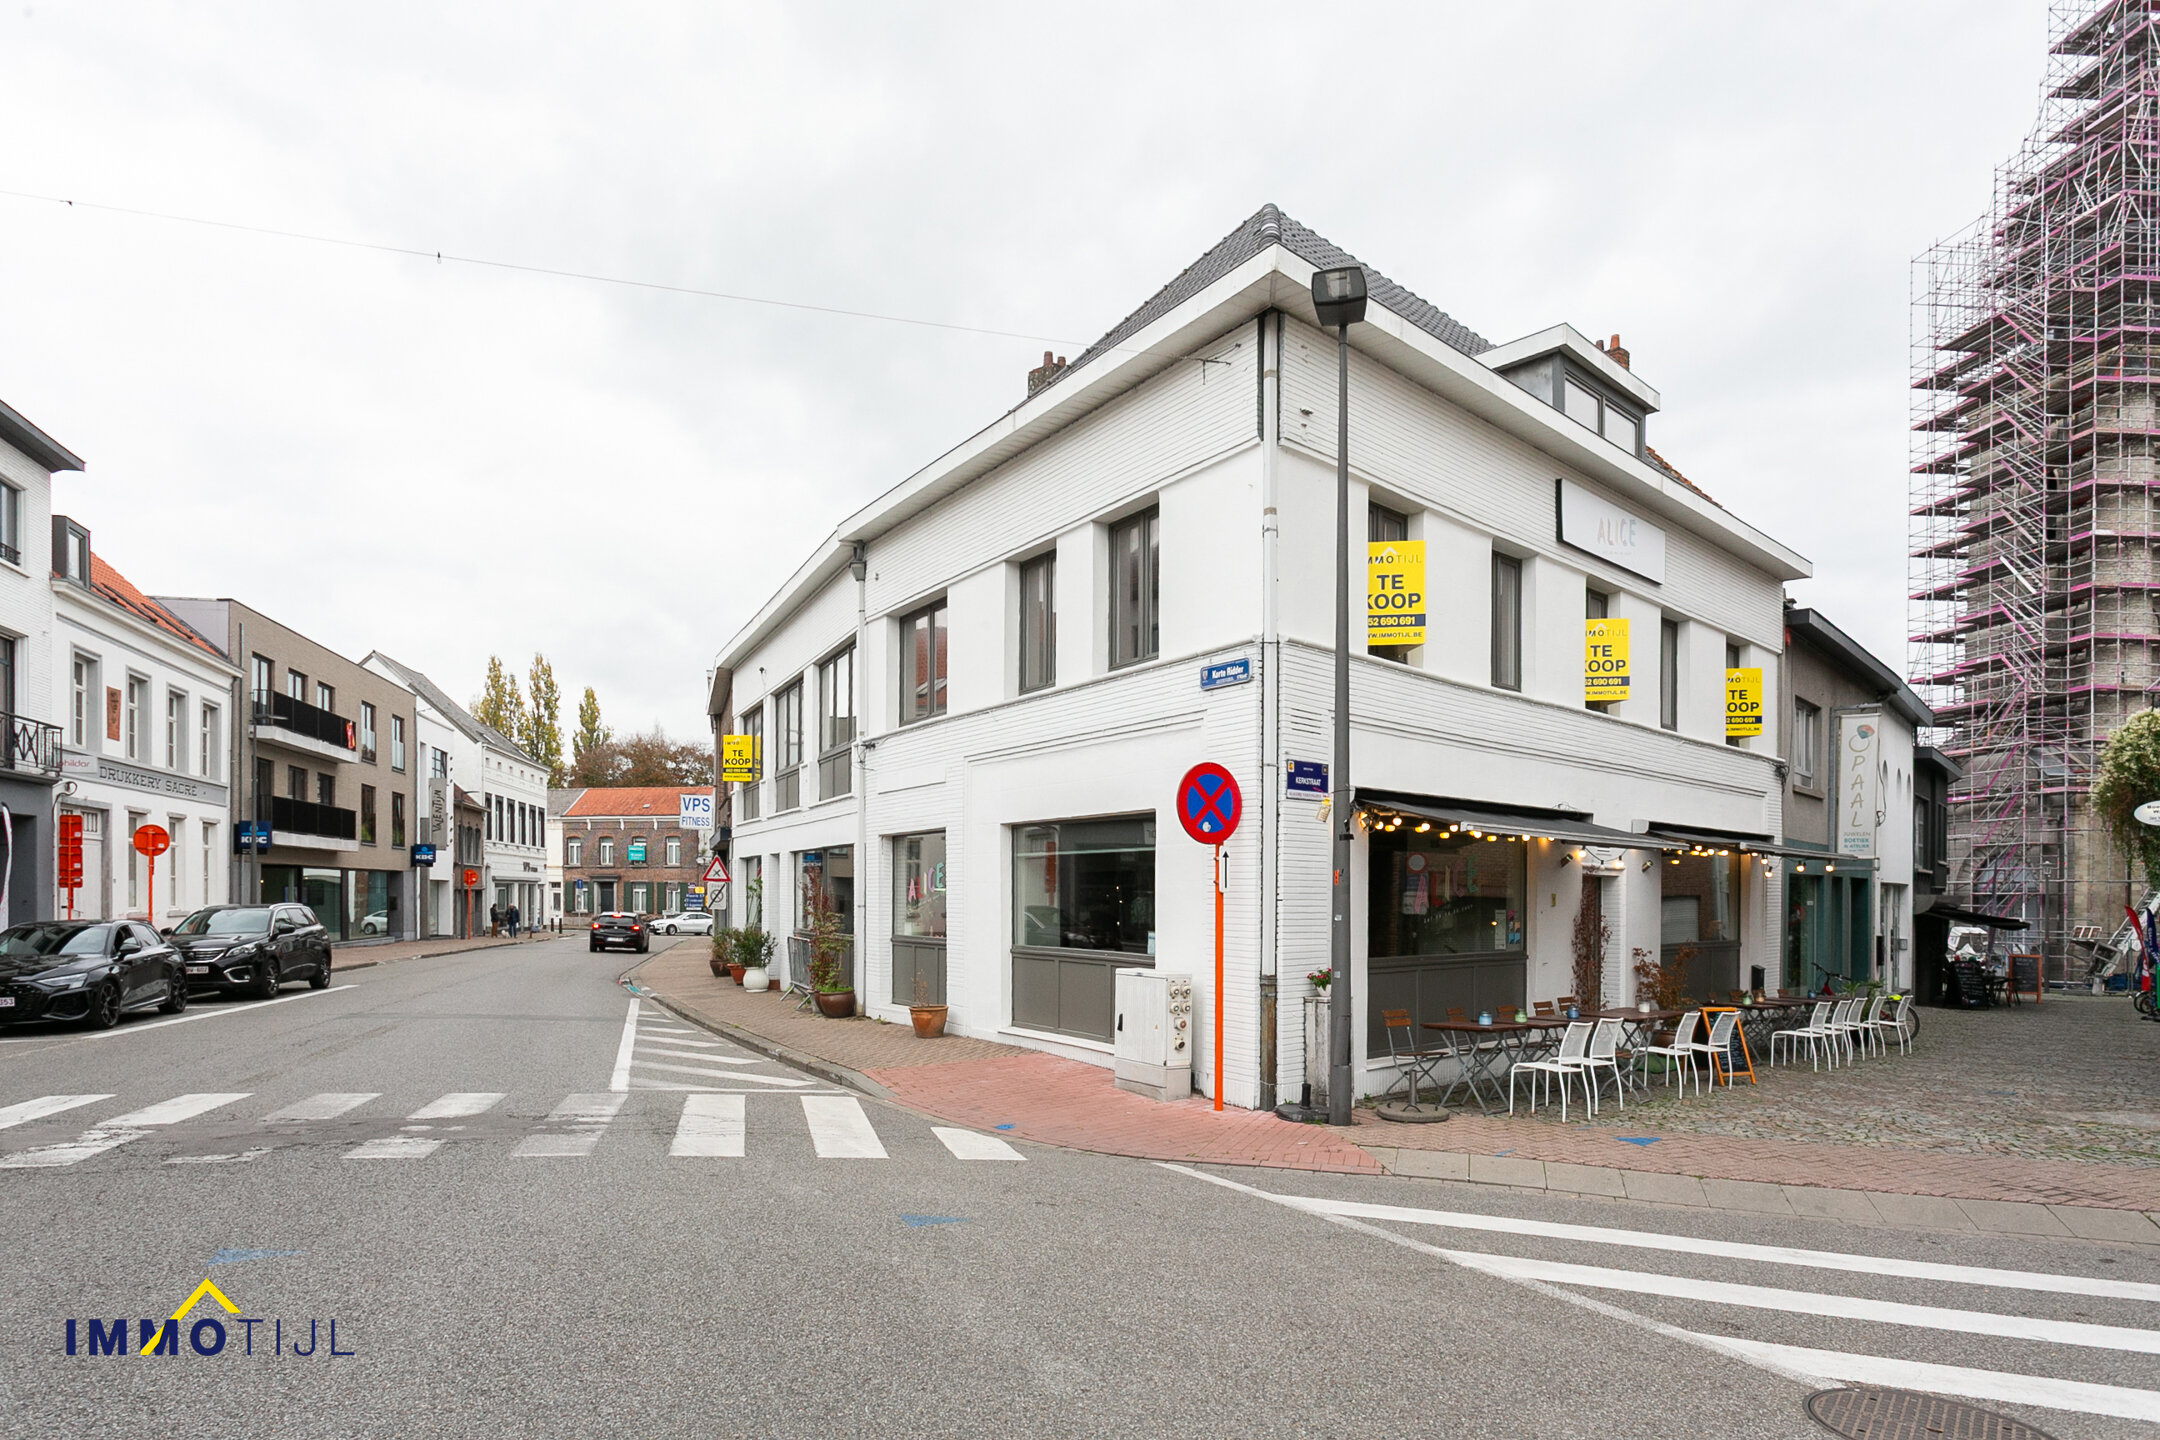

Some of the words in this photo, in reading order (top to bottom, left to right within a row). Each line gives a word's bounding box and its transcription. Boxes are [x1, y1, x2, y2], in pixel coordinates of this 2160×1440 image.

[1597, 517, 1636, 547] ALICE
[1376, 574, 1404, 590] TE
[1380, 617, 1398, 625] 690
[1399, 616, 1415, 625] 691
[1585, 629, 1627, 637] MOTIJL
[1590, 645, 1612, 657] TE
[1226, 665, 1244, 676] Ridder
[1585, 659, 1626, 672] OOP
[1729, 690, 1748, 700] TE
[1726, 702, 1760, 713] OOP
[99, 766, 161, 790] DRUKKERY
[1295, 777, 1321, 786] KERKSTRAAT
[683, 797, 711, 812] VPS
[682, 816, 710, 827] FITNESS
[907, 862, 945, 903] ALICE
